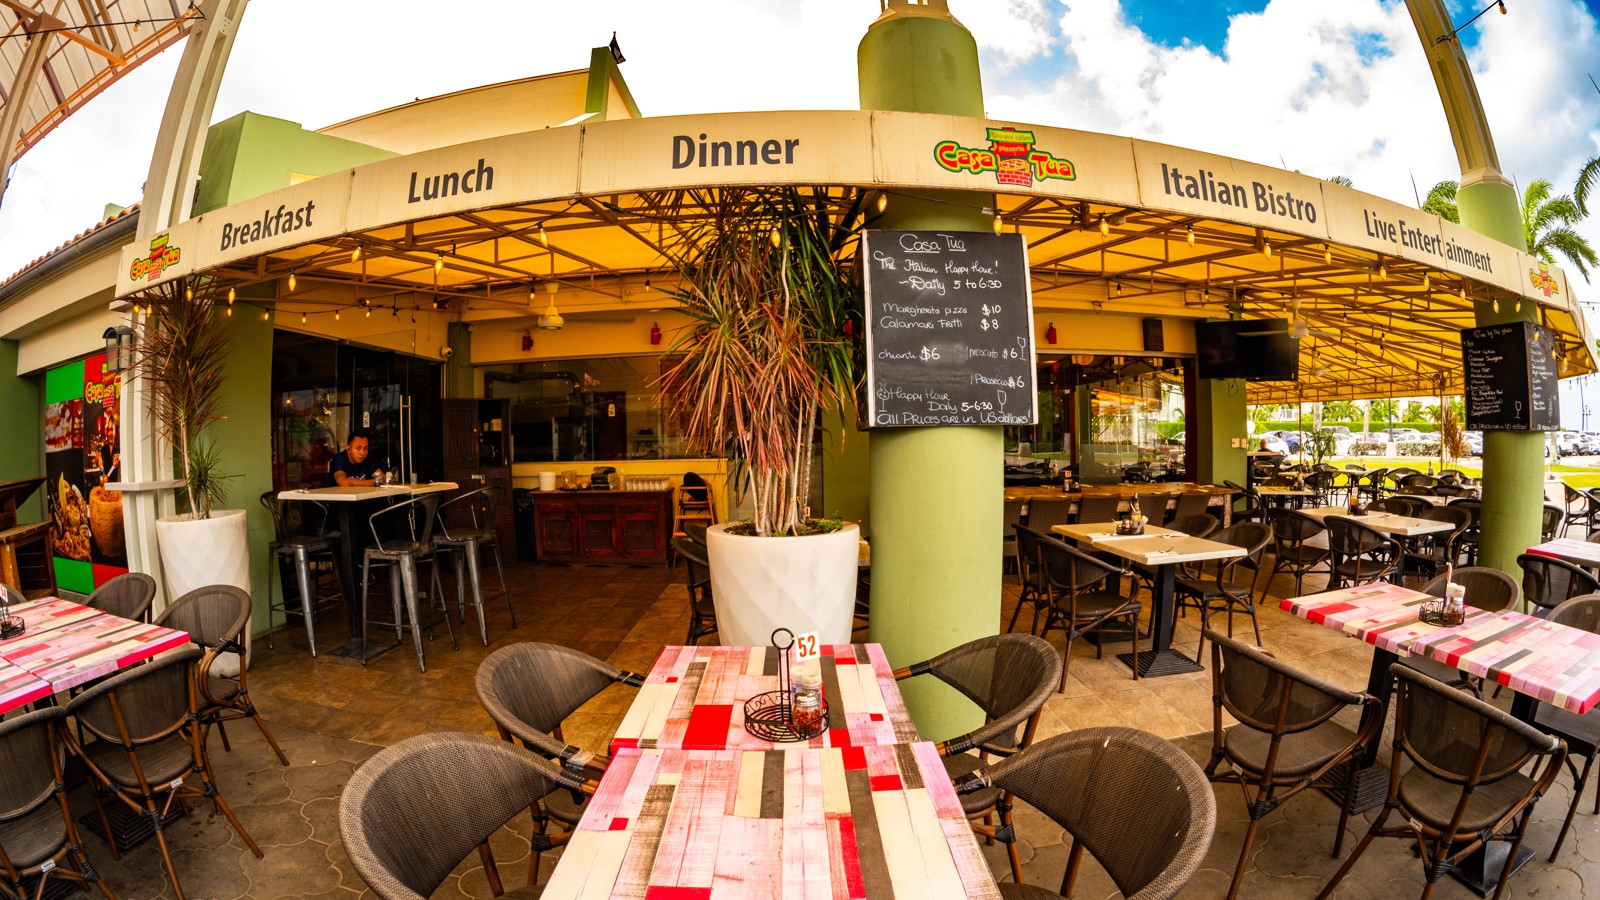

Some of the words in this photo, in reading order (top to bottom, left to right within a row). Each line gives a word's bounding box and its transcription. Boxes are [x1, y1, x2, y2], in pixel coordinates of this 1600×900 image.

[672, 133, 799, 169] Dinner
[936, 143, 996, 172] Casa
[1029, 152, 1074, 179] Tua
[408, 158, 493, 204] Lunch
[1161, 163, 1248, 209] Italian
[1252, 181, 1316, 224] Bistro
[220, 200, 315, 251] Breakfast
[1363, 209, 1397, 244] Live
[899, 233, 941, 251] Casa
[937, 233, 965, 250] Tua
[873, 250, 896, 270] The
[904, 259, 938, 274] Italian
[945, 260, 969, 275] Happy
[953, 280, 961, 290] 5
[965, 279, 977, 289] to
[979, 277, 1002, 289] 6:30
[981, 303, 1001, 317] $10
[919, 345, 940, 362] $6
[86, 381, 104, 404] Casa
[889, 386, 923, 402] Happy
[925, 389, 951, 401] Hour
[927, 401, 958, 414] Daily
[941, 415, 961, 425] are
[980, 411, 998, 424] US
[797, 635, 817, 658] 52
